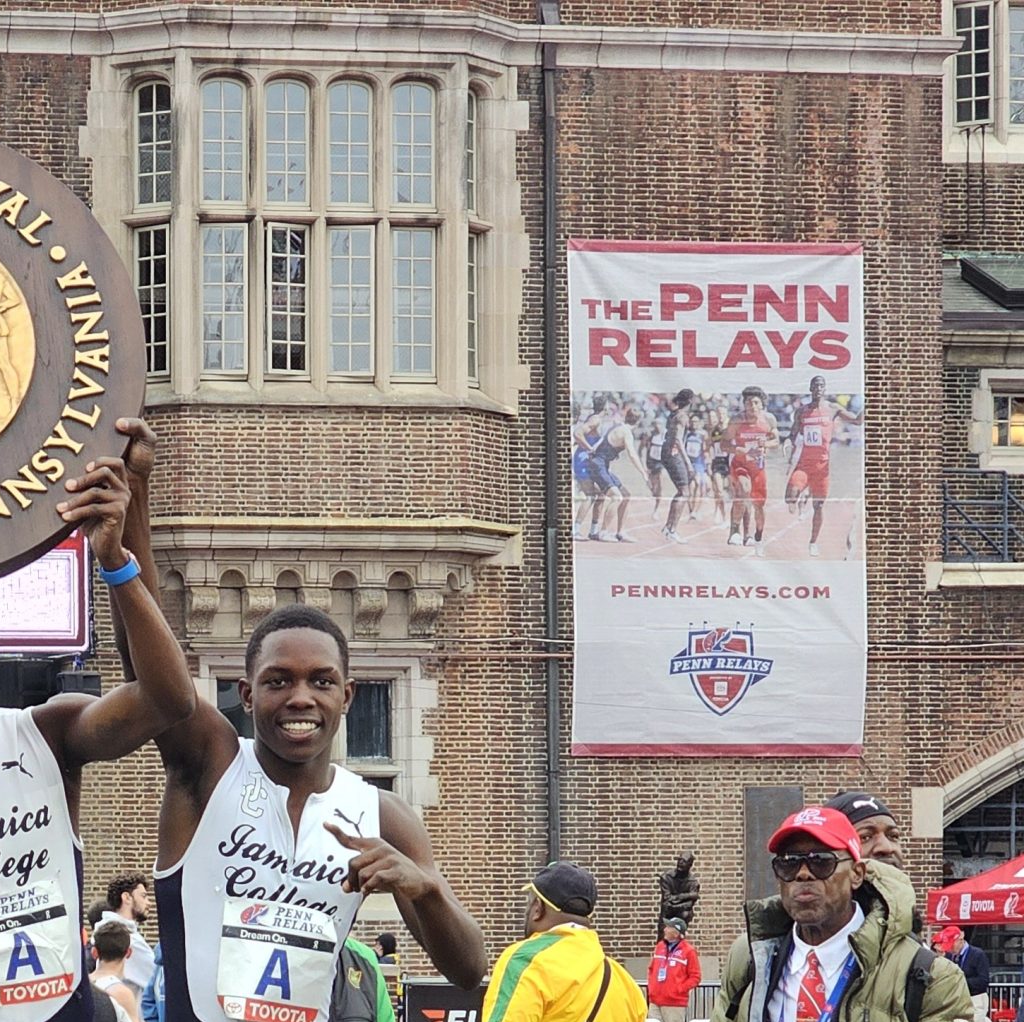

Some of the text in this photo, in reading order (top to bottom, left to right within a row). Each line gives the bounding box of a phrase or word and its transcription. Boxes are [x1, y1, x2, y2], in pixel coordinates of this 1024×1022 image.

[581, 283, 850, 323] THE PENN
[588, 329, 852, 369] RELAYS
[611, 585, 831, 599] PENNRELAYS.COM
[673, 658, 771, 672] PENN RELAYS
[218, 824, 349, 886] Jamaic
[0, 887, 36, 905] PENN
[1, 894, 49, 915] RELAYS
[276, 908, 313, 921] PENN
[971, 900, 995, 912] TOYOTA
[239, 929, 270, 942] Dream
[273, 917, 324, 935] RELAYS
[6, 930, 44, 981] A
[254, 948, 291, 1001] A
[3, 979, 68, 1002] TOYOTA
